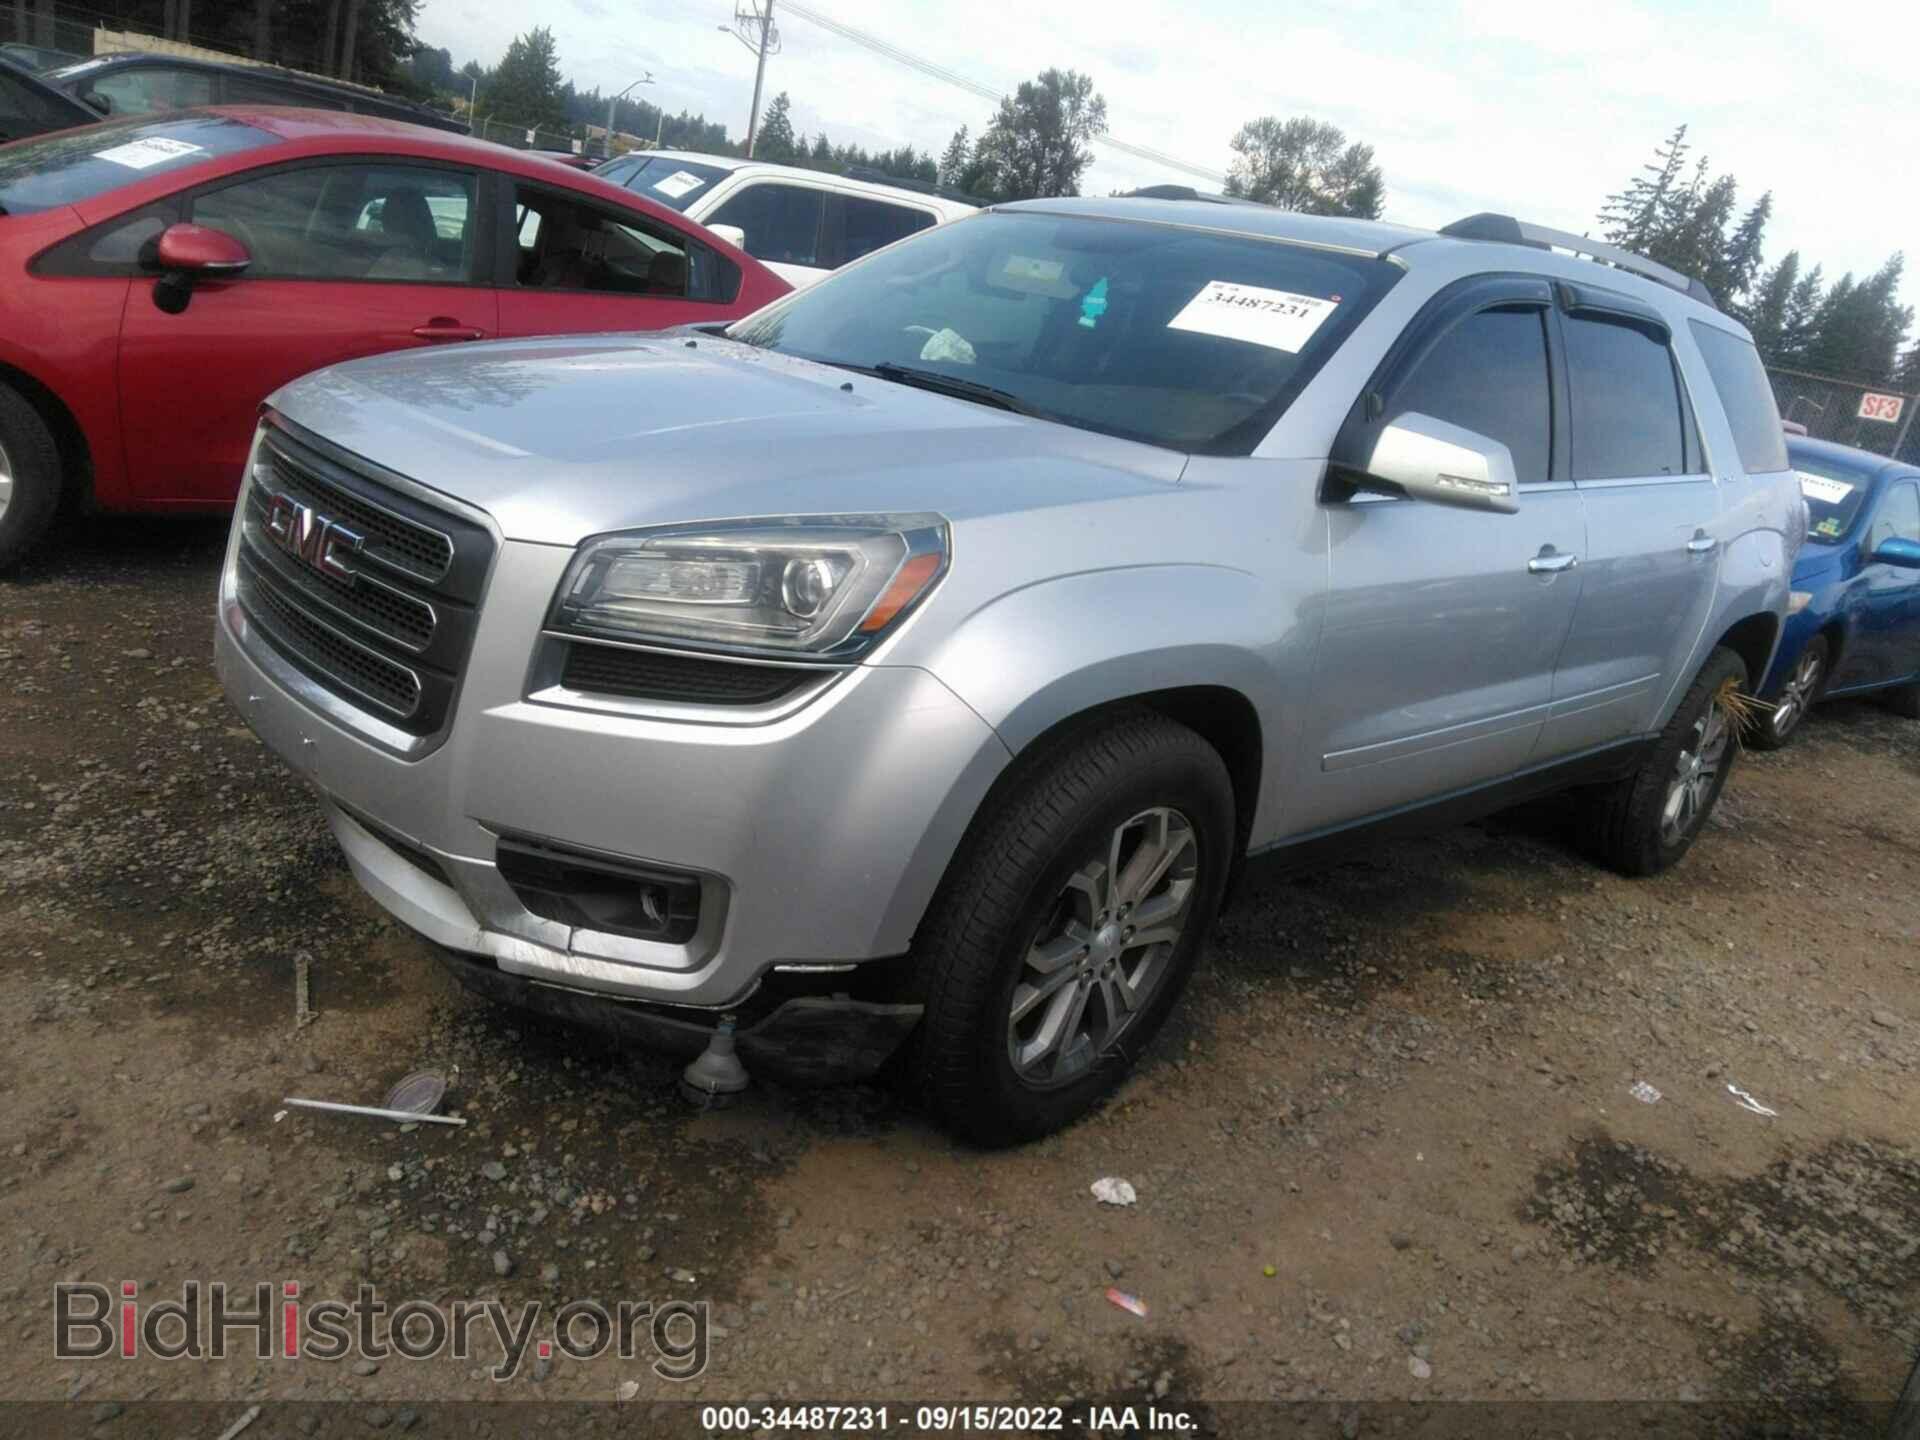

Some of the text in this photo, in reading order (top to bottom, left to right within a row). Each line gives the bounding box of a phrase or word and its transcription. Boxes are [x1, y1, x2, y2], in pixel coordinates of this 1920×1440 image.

[1208, 292, 1309, 318] 34487231
[1864, 396, 1899, 418] SF3
[266, 491, 364, 588] GMC
